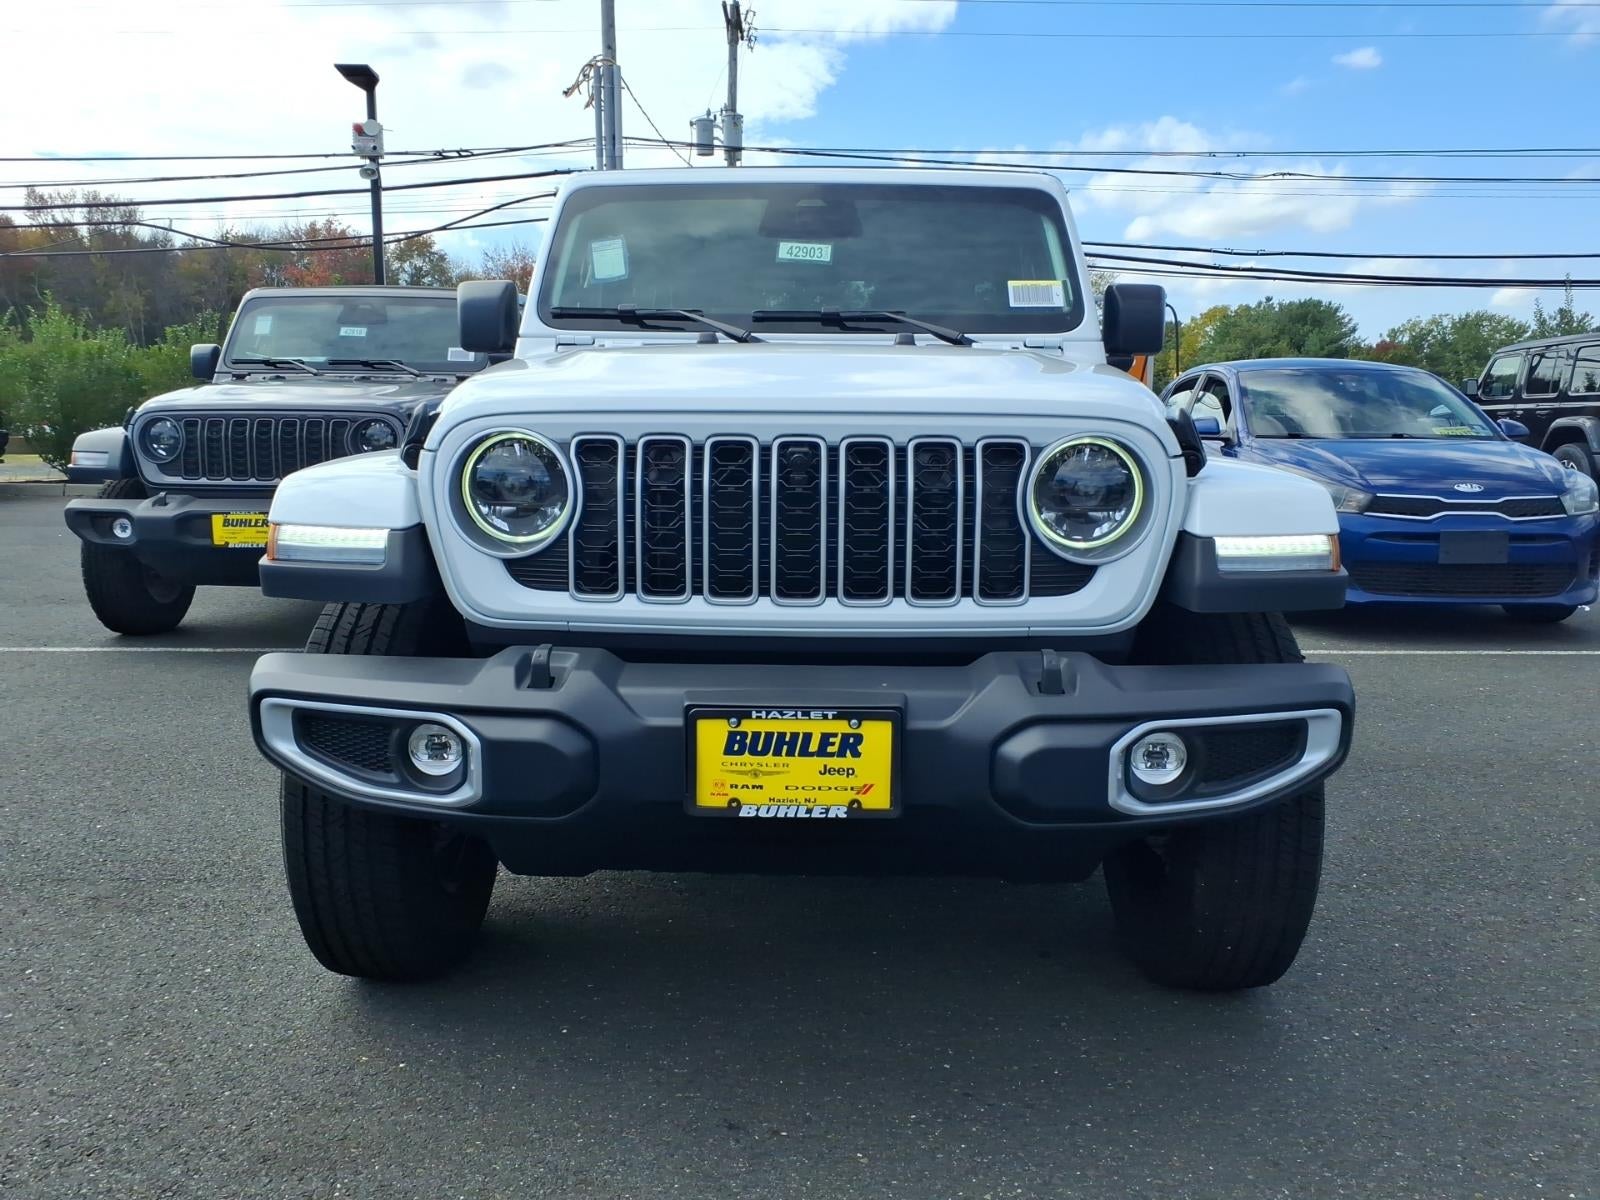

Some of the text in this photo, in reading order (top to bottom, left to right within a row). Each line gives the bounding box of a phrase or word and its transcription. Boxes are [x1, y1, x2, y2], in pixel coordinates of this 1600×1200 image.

[786, 245, 824, 259] 42903
[223, 518, 269, 528] BUHLER
[751, 710, 838, 720] HAZLET
[723, 730, 864, 759] BUHLER
[819, 764, 855, 778] Jeep
[738, 804, 848, 818] BUHLER
